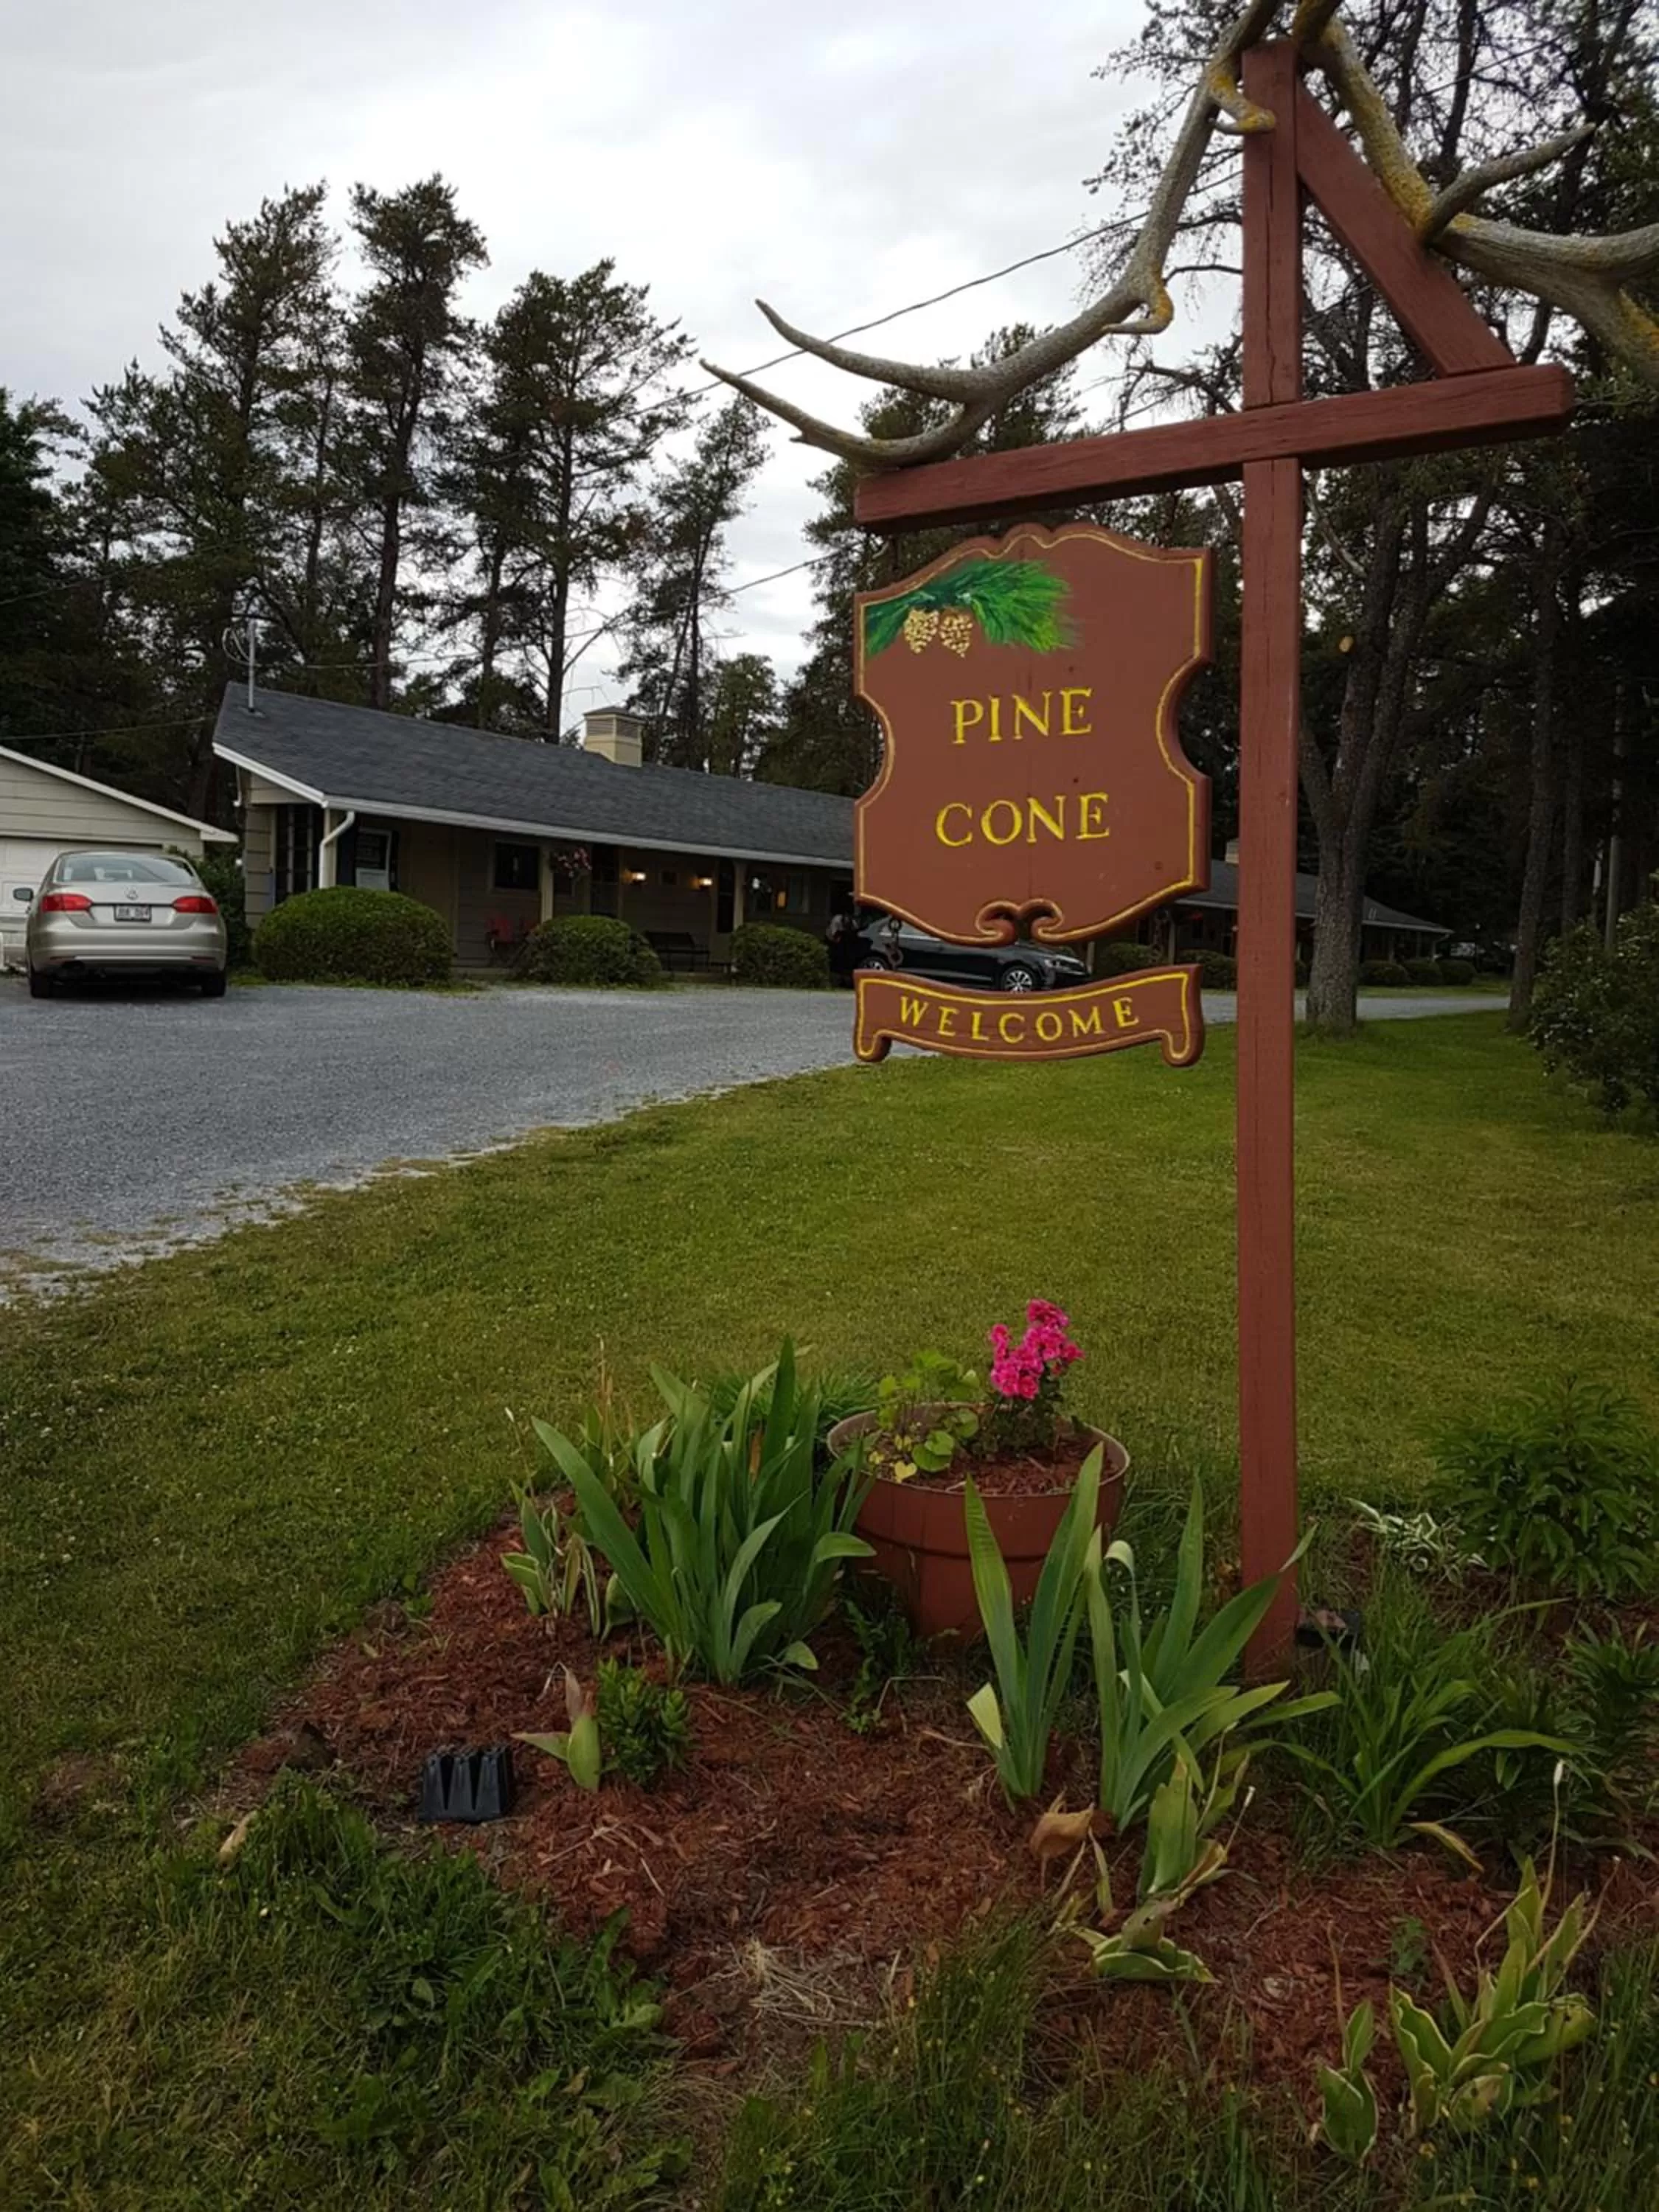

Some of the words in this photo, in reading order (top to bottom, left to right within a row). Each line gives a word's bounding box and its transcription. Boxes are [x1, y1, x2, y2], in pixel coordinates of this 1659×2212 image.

[950, 687, 1092, 745] PINE
[935, 792, 1109, 846] CONE
[899, 995, 1139, 1043] WELCOME
